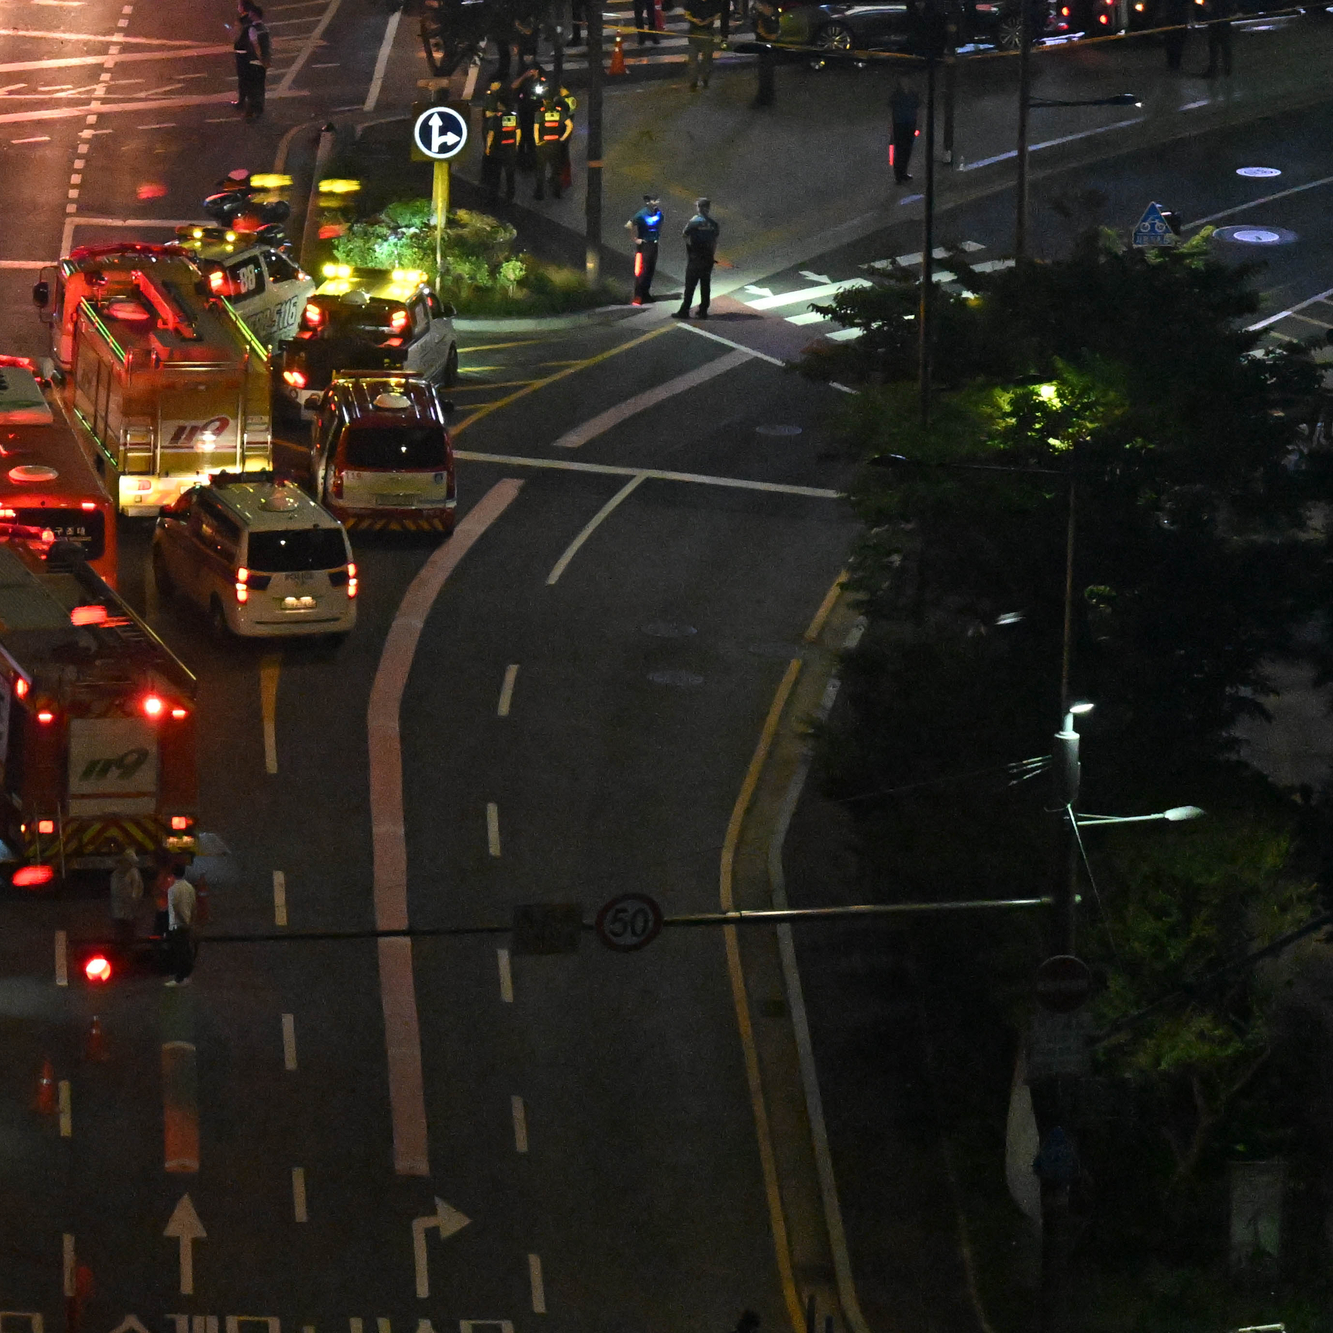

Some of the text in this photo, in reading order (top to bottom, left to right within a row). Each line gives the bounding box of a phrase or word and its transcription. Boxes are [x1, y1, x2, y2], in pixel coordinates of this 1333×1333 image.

[168, 416, 231, 445] 119
[78, 747, 150, 782] 119
[609, 907, 650, 938] 50
